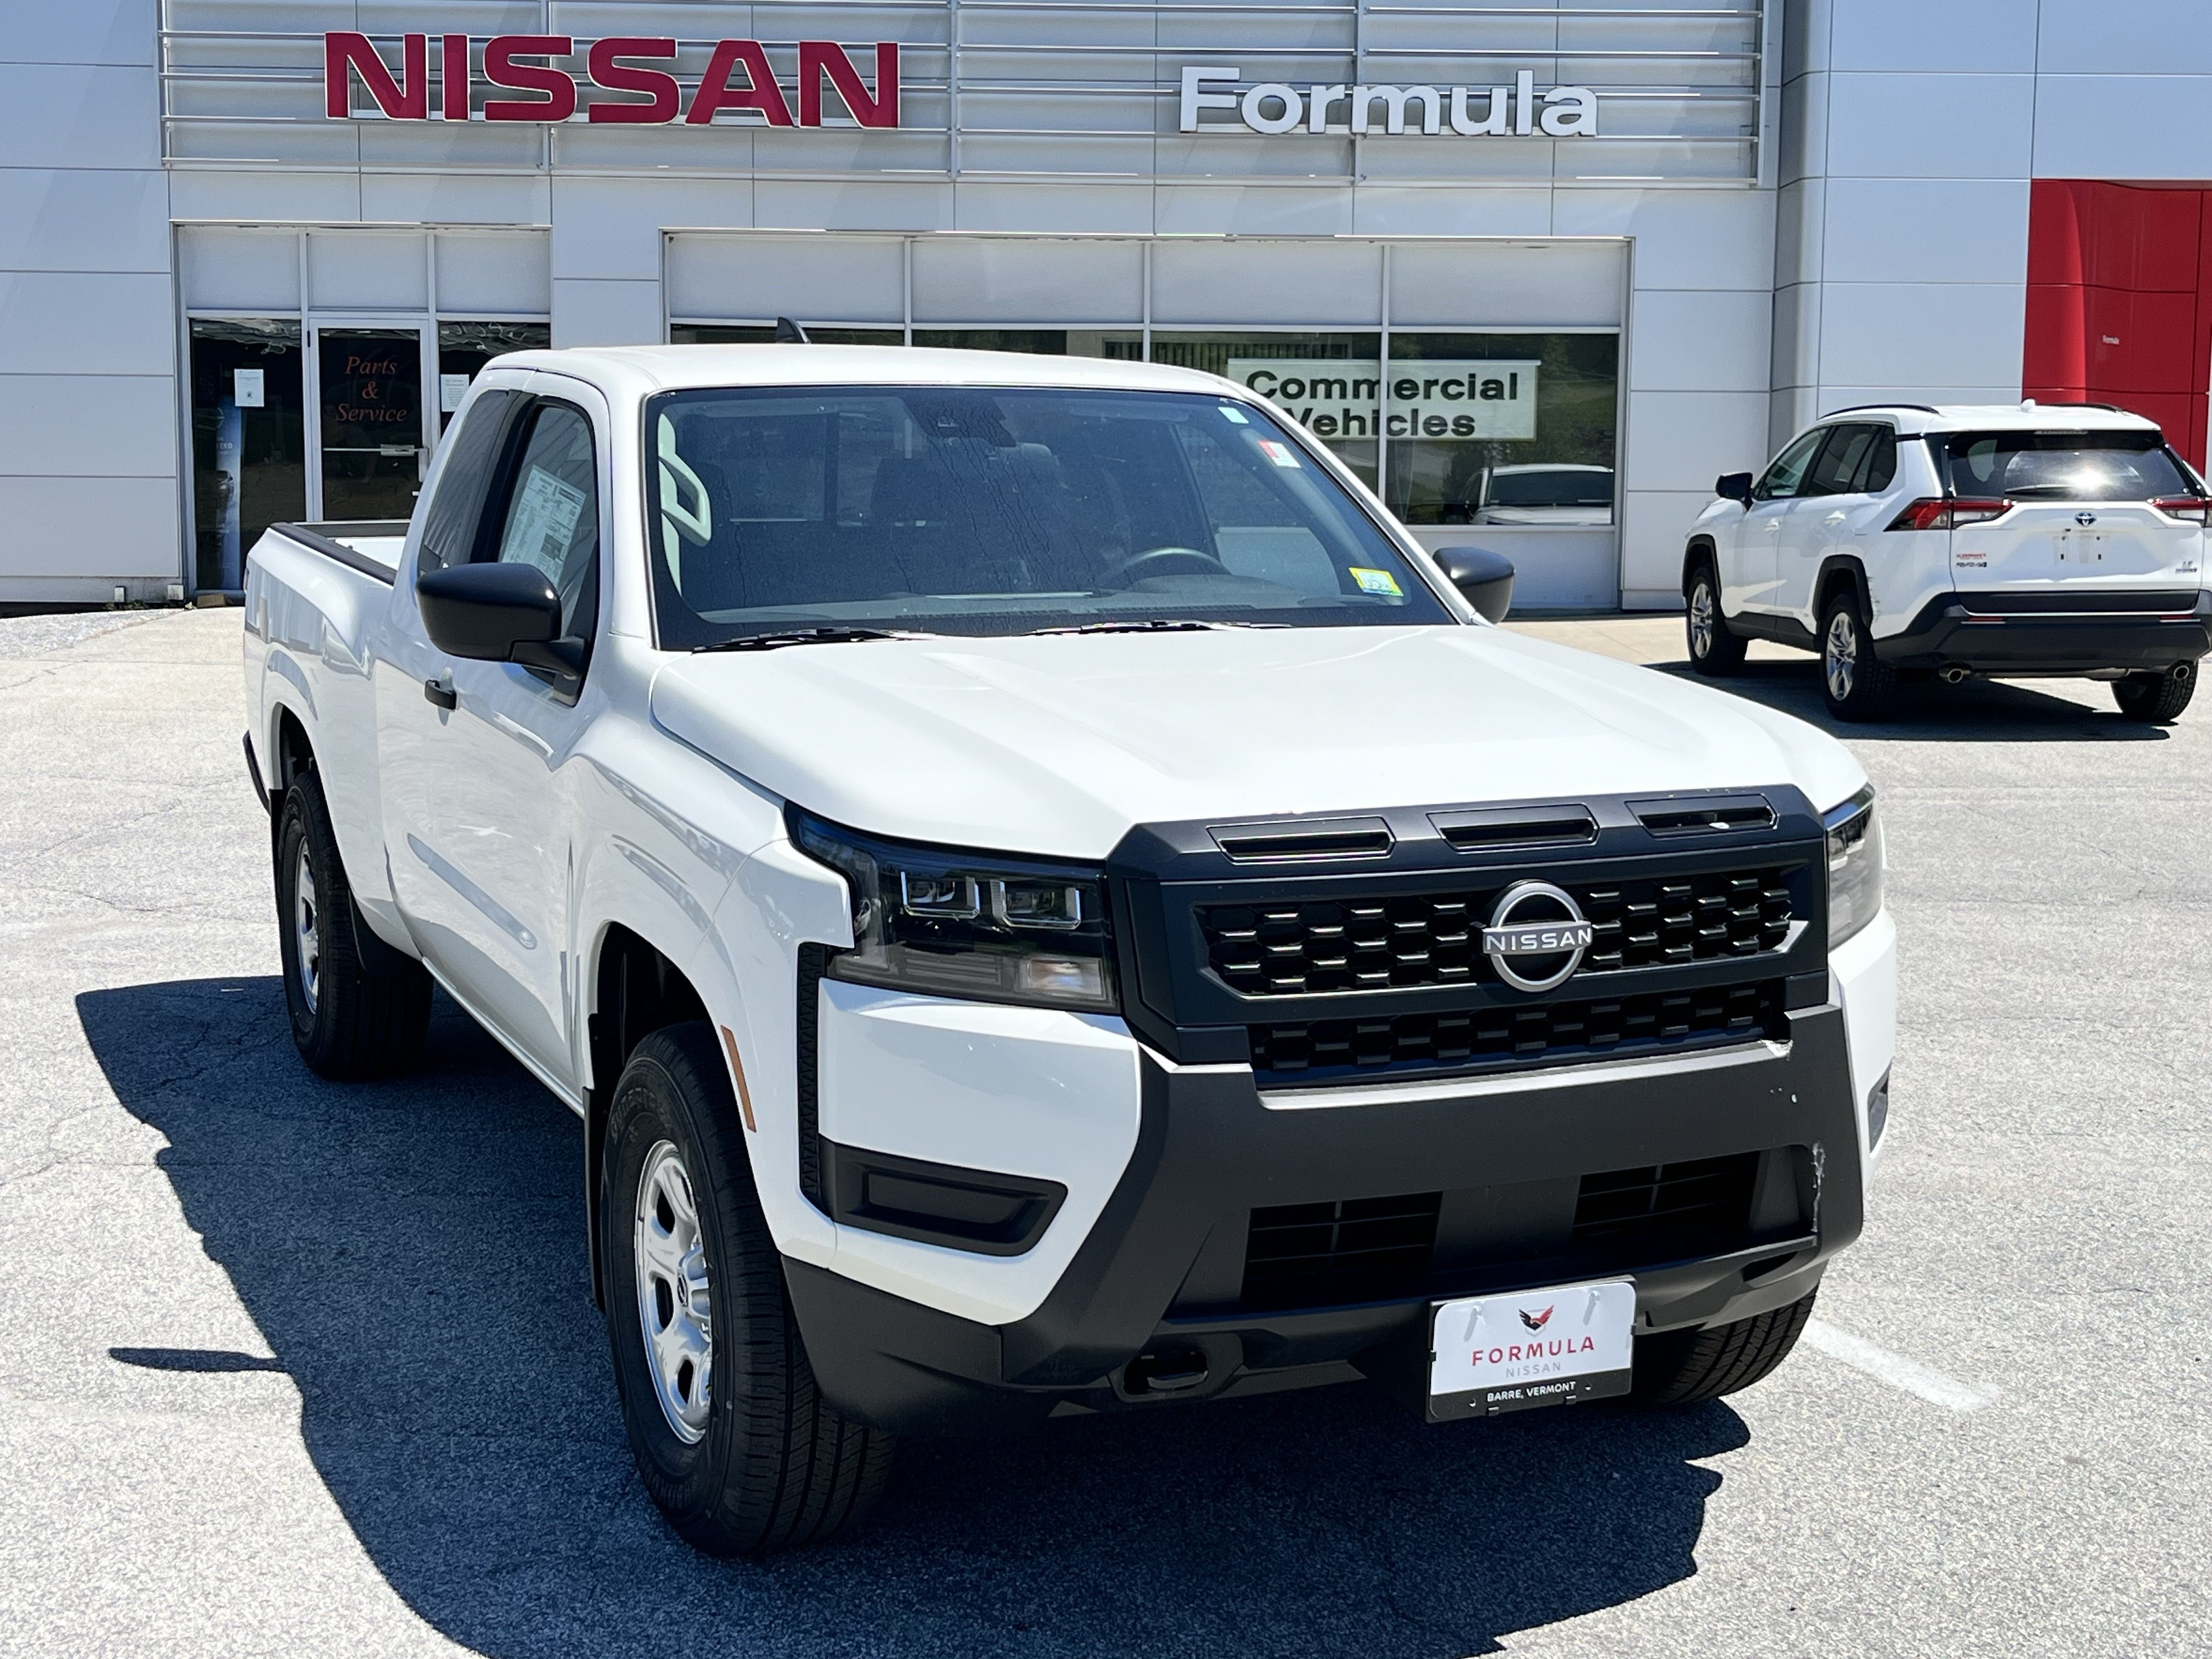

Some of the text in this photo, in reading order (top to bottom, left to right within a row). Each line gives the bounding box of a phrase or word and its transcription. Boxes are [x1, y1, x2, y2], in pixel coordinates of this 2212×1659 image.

[324, 31, 900, 129] NISSAN
[1180, 66, 1598, 137] Formula
[344, 356, 397, 374] Parts
[362, 380, 379, 399] &
[1246, 370, 1518, 401] Commercial
[336, 403, 407, 422] Service
[1283, 408, 1475, 437] Vehicles
[1486, 928, 1592, 951] NISSAN
[1471, 1335, 1595, 1367] FORMULA
[1505, 1361, 1561, 1378] NISSAN
[1487, 1381, 1577, 1403] BARRE, VERMONT
